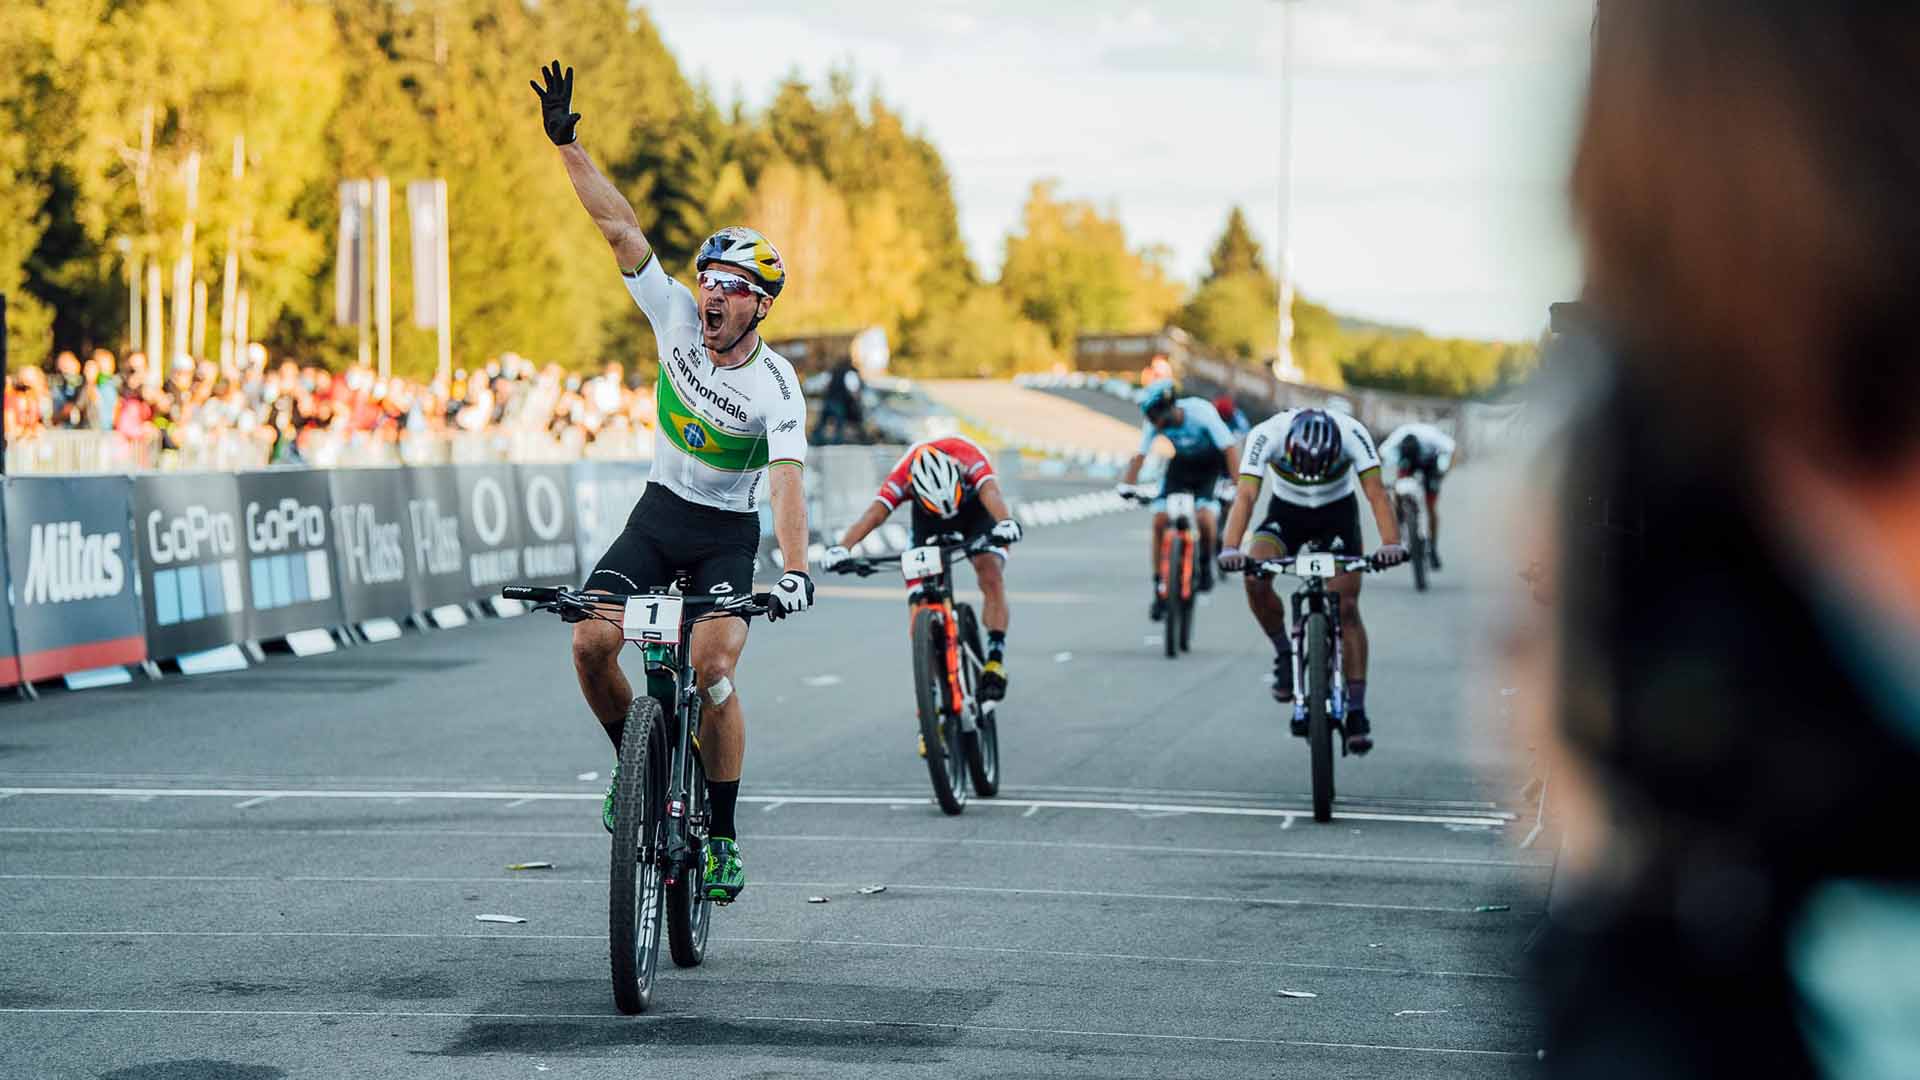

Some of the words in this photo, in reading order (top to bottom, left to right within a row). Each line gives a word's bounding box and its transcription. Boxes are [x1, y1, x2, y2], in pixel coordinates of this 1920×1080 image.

[672, 346, 748, 423] cannondale
[763, 357, 791, 400] cannondale
[147, 505, 236, 564] GoPro
[246, 498, 326, 552] GoPro
[24, 521, 124, 606] Mitas
[914, 551, 926, 563] 4
[1309, 559, 1321, 573] 6
[645, 602, 659, 625] 1
